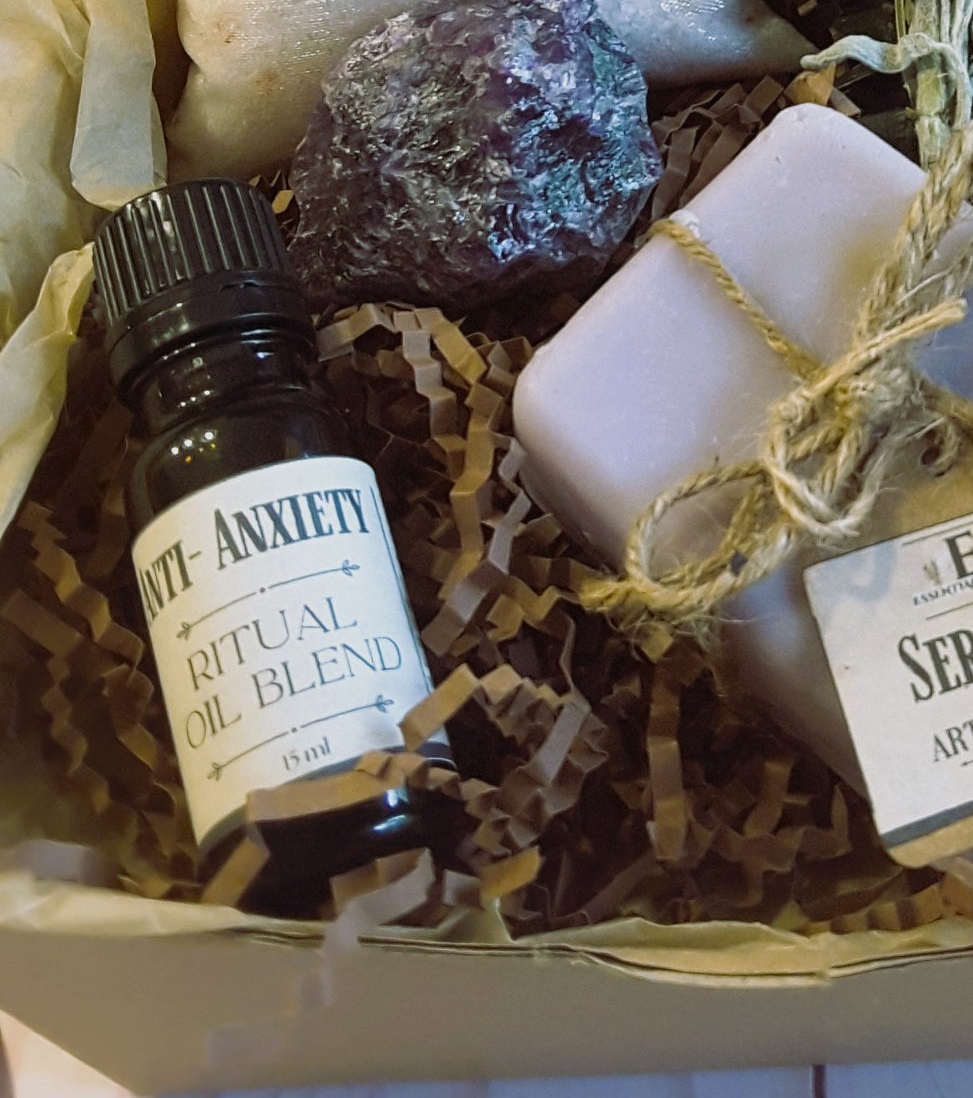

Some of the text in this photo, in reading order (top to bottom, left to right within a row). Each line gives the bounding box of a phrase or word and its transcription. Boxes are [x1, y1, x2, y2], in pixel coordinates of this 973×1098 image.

[213, 487, 370, 571] ANXIETY
[186, 596, 358, 693] RITUAL
[185, 635, 403, 750] OIL BLEND
[280, 736, 331, 772] 15 ml
